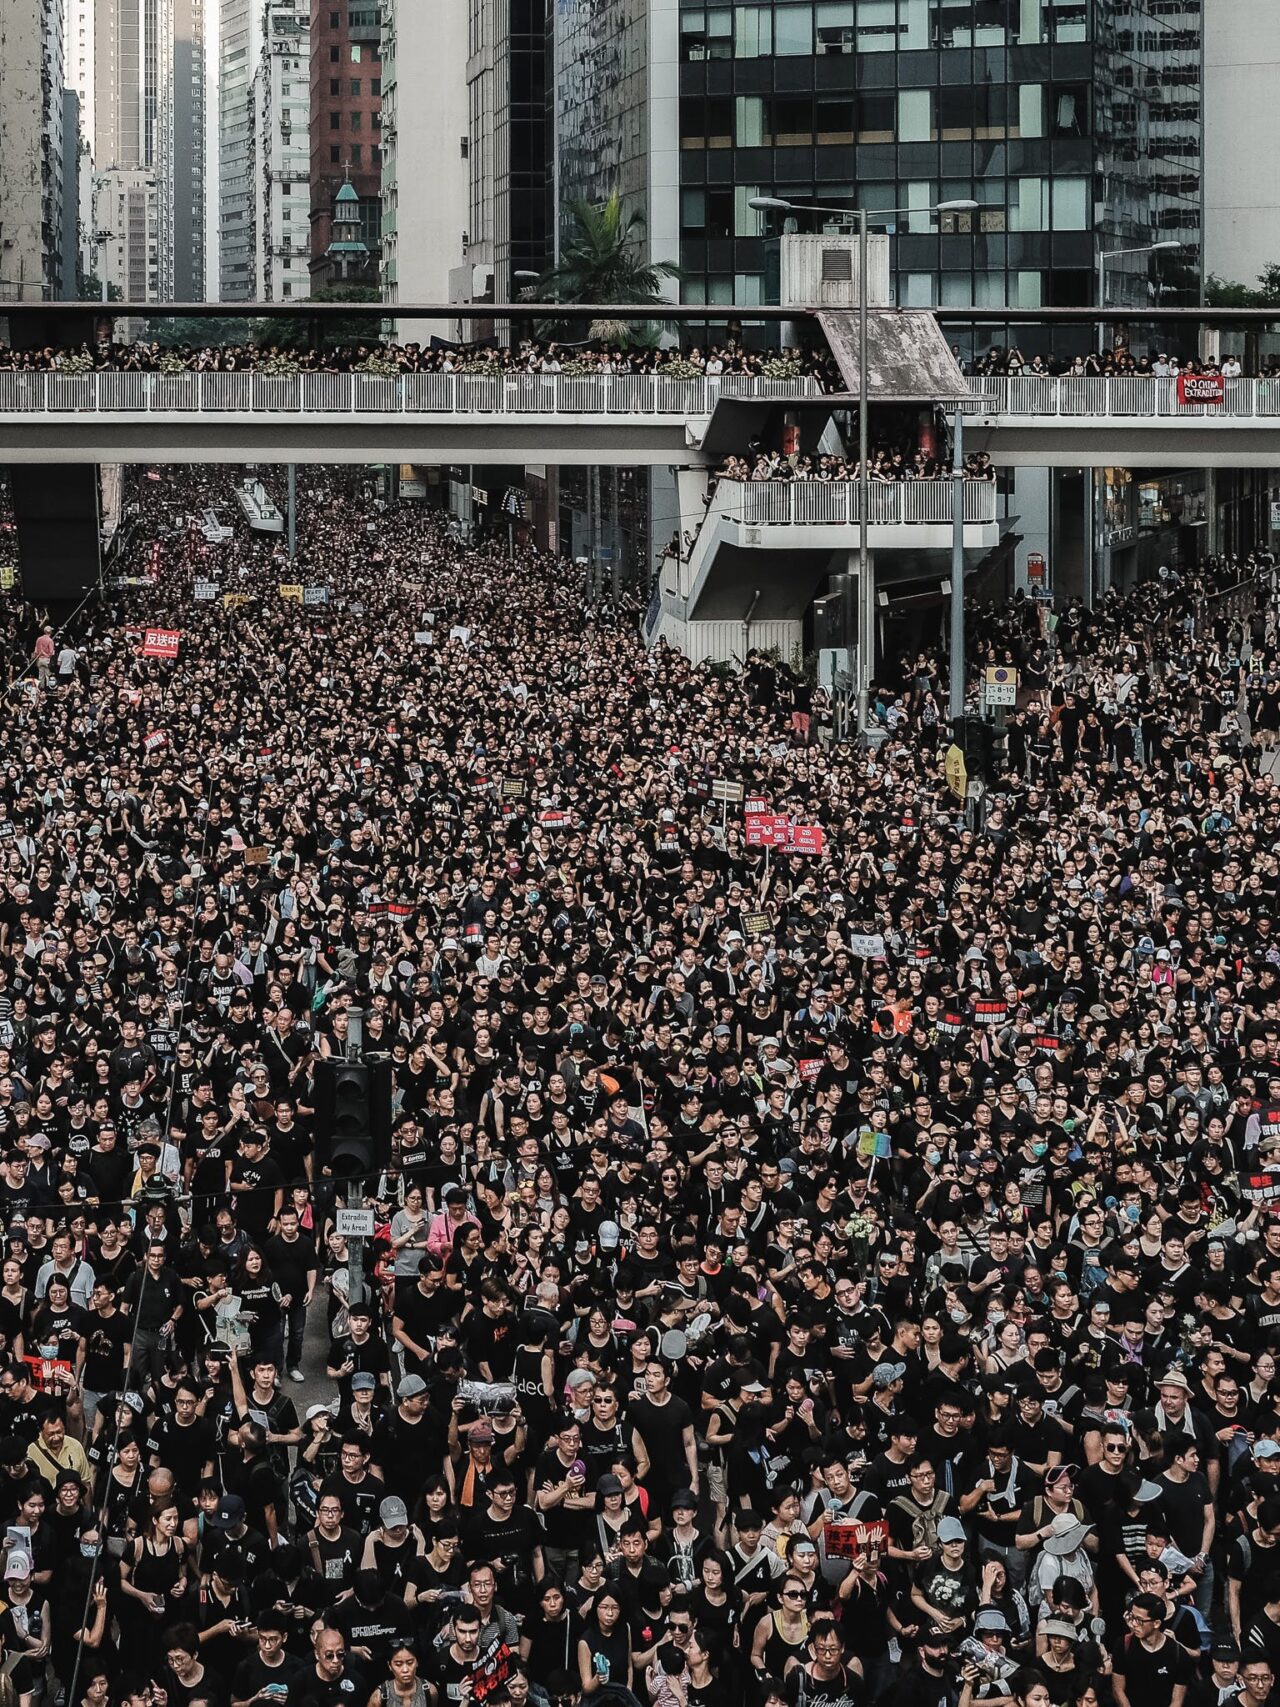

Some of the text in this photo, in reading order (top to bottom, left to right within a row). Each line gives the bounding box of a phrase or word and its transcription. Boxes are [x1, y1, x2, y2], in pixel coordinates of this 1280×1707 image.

[1183, 379, 1219, 389] NO CHINA
[147, 633, 178, 648] 反送中
[341, 1212, 367, 1221] Extradite
[341, 1223, 349, 1232] My
